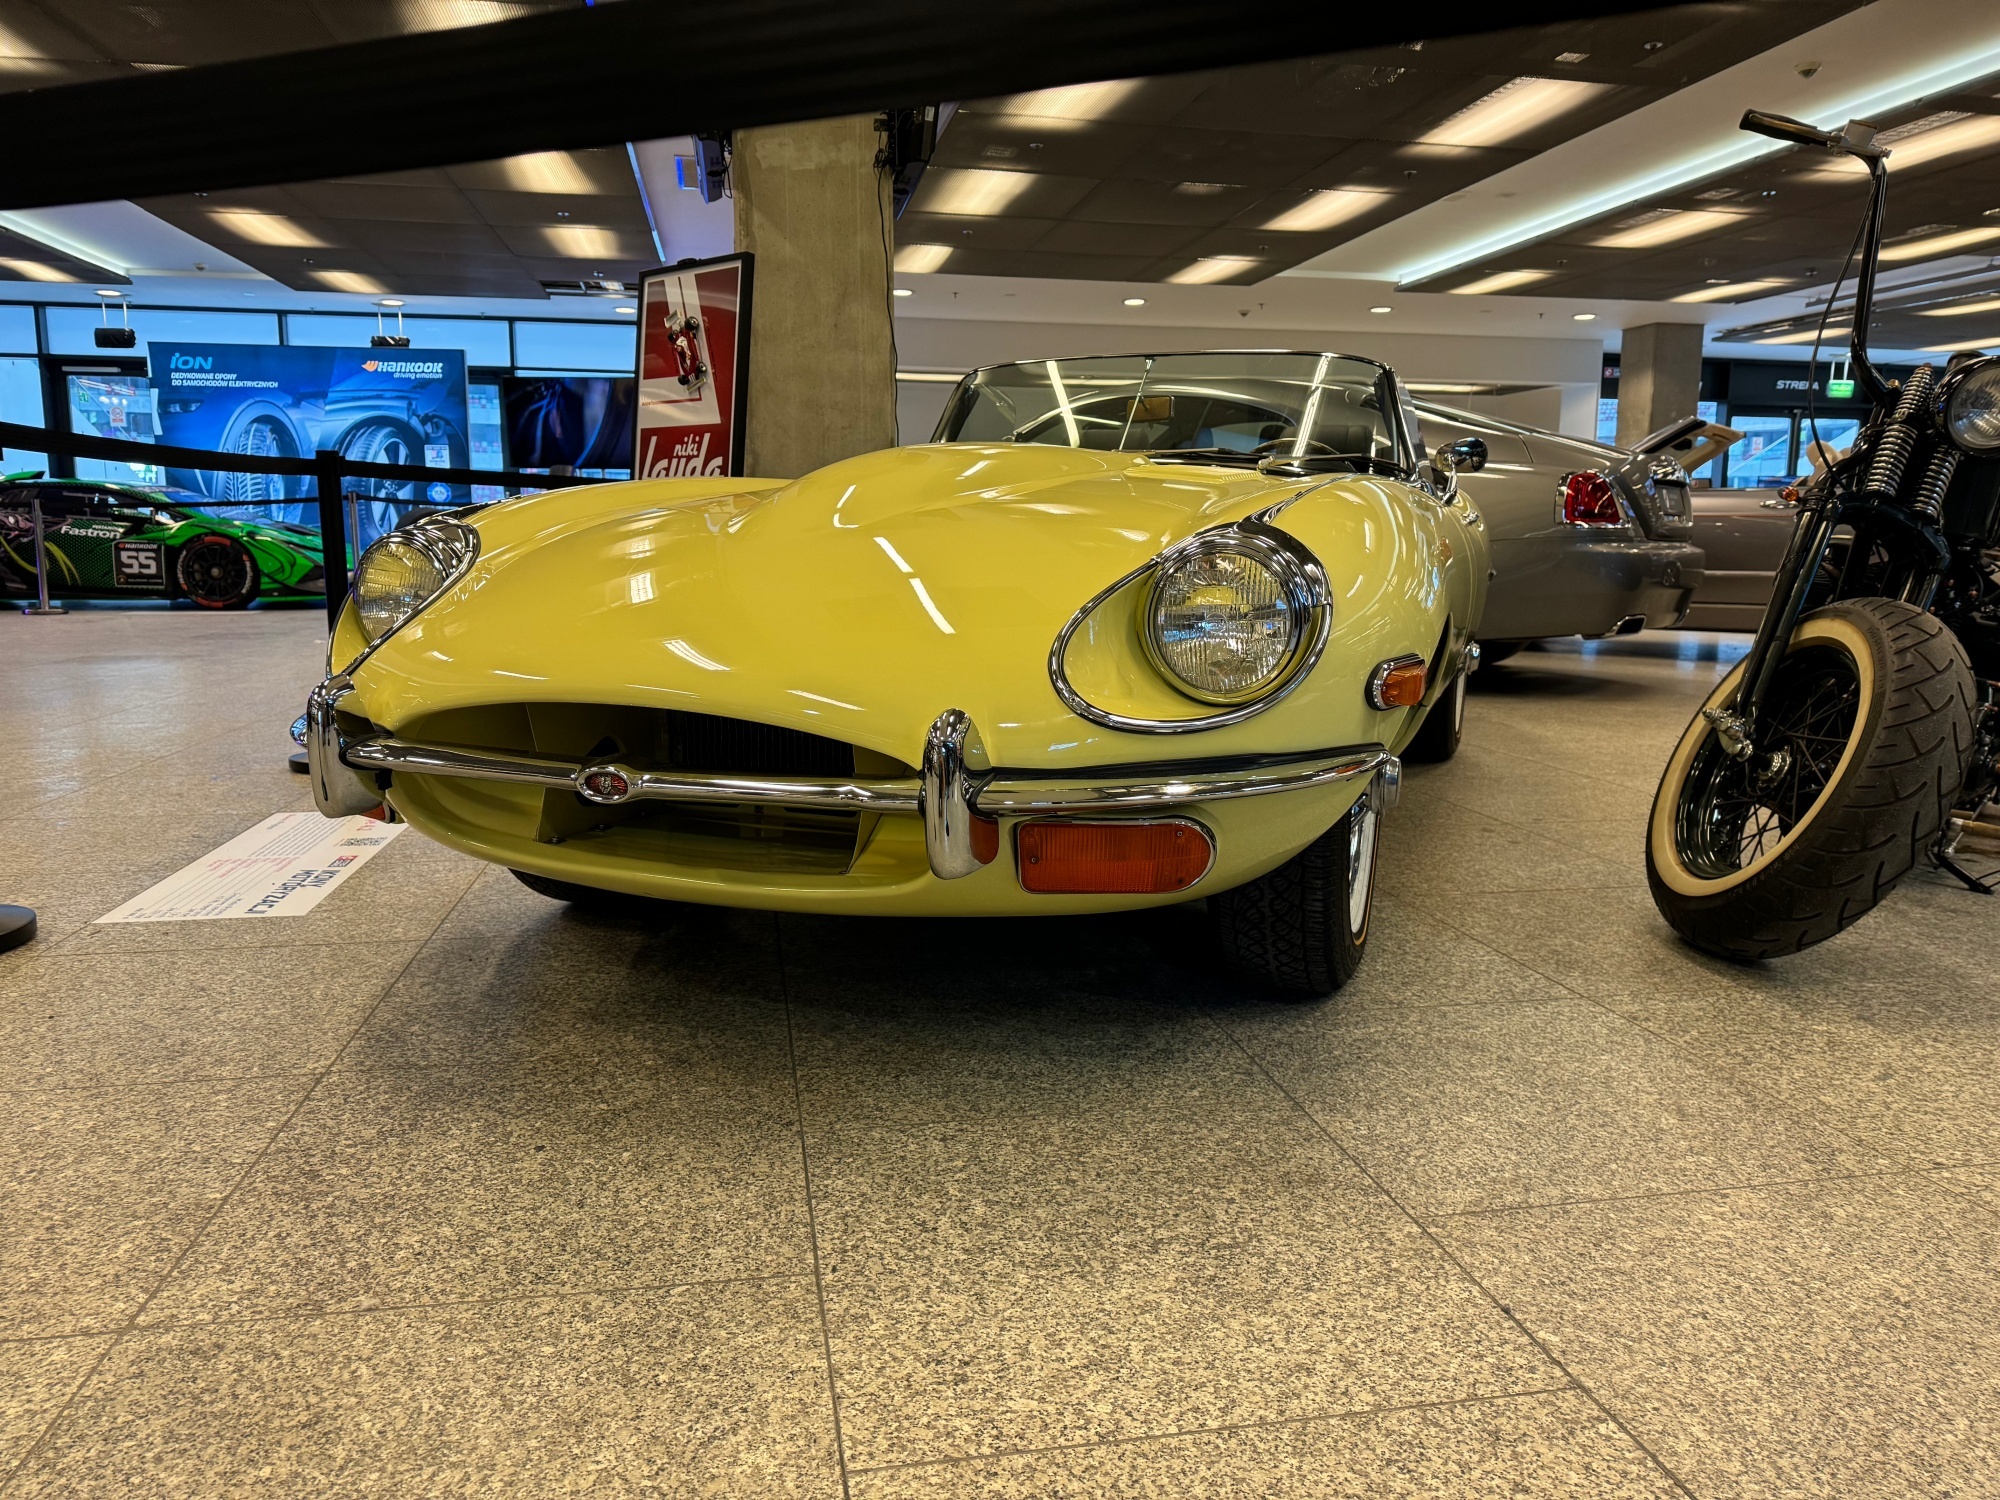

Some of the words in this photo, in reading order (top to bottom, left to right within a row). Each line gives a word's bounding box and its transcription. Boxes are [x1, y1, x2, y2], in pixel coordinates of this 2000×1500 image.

[171, 372, 214, 380] DEDYKOWANE
[393, 372, 415, 380] driving
[228, 380, 279, 389] ELEKTRYCZNYCH
[673, 433, 700, 457] niki
[60, 525, 121, 539] Fastron
[120, 551, 157, 575] 55
